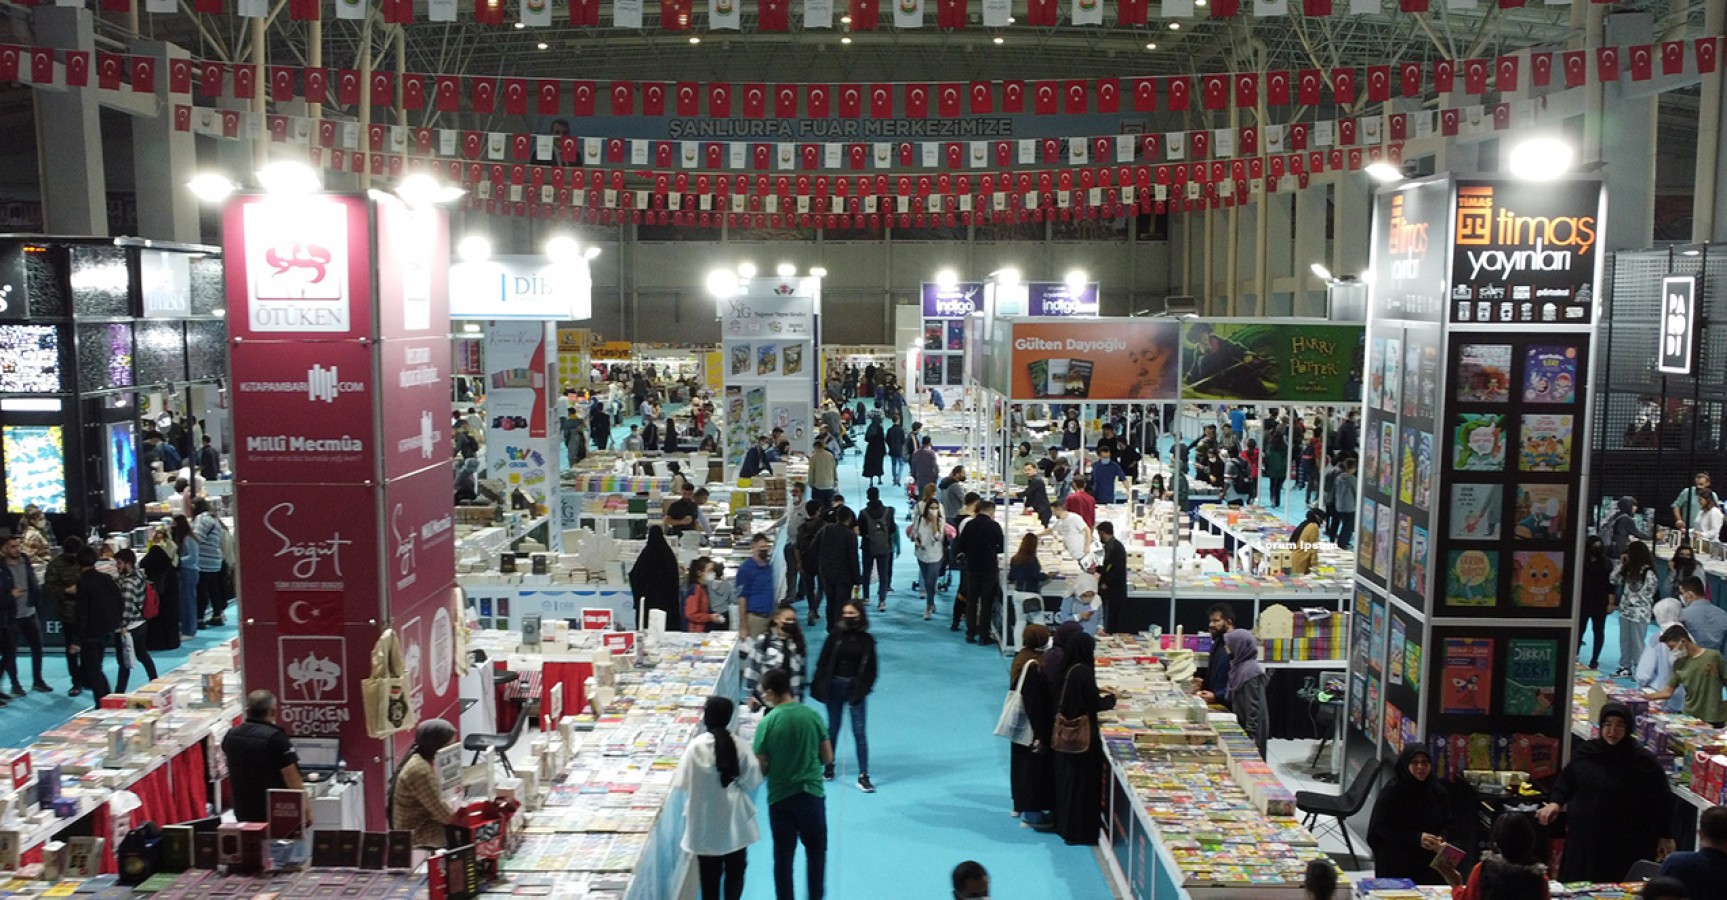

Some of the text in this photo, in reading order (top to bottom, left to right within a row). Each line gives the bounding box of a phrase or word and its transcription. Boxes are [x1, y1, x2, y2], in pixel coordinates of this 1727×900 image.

[669, 118, 793, 139] ŞANLIURFA
[799, 119, 858, 137] FUAR
[1497, 207, 1595, 255] timaş
[1467, 237, 1572, 280] yayınları
[254, 304, 343, 326] ÖTÜKEN
[1015, 337, 1127, 352] Gülten Dayıoğlu
[1291, 336, 1337, 355] HARRY
[1289, 357, 1339, 376] POTTER
[263, 502, 352, 578] Söğüt
[281, 704, 350, 723] ÖTÜKEN
